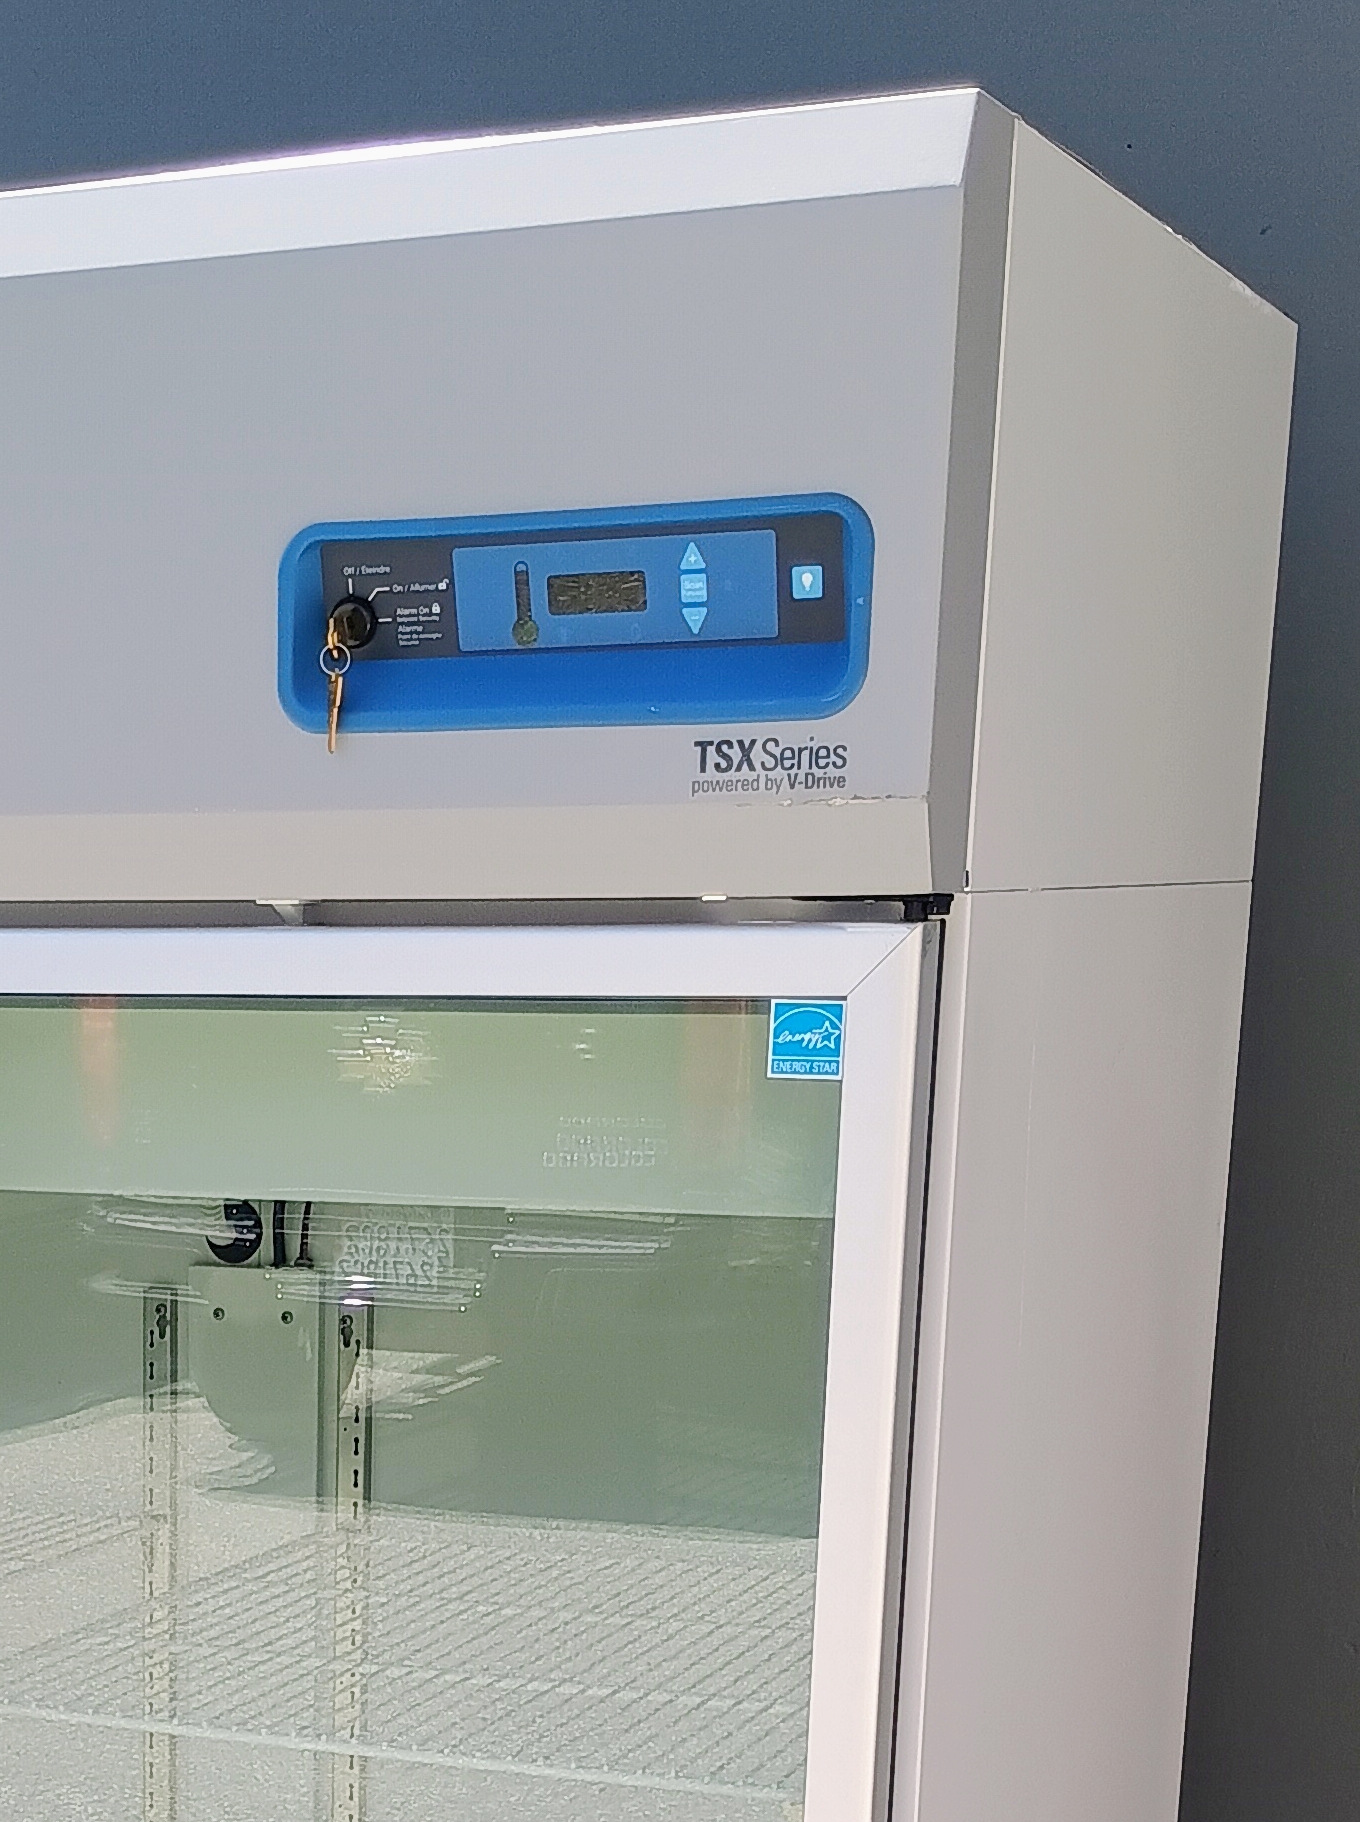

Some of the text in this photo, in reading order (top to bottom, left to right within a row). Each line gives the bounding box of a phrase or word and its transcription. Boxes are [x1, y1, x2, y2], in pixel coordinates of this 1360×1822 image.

[693, 735, 848, 774] TSX Series
[691, 771, 847, 798] powered by V-Drive
[773, 1060, 838, 1075] ENERGY STAR
